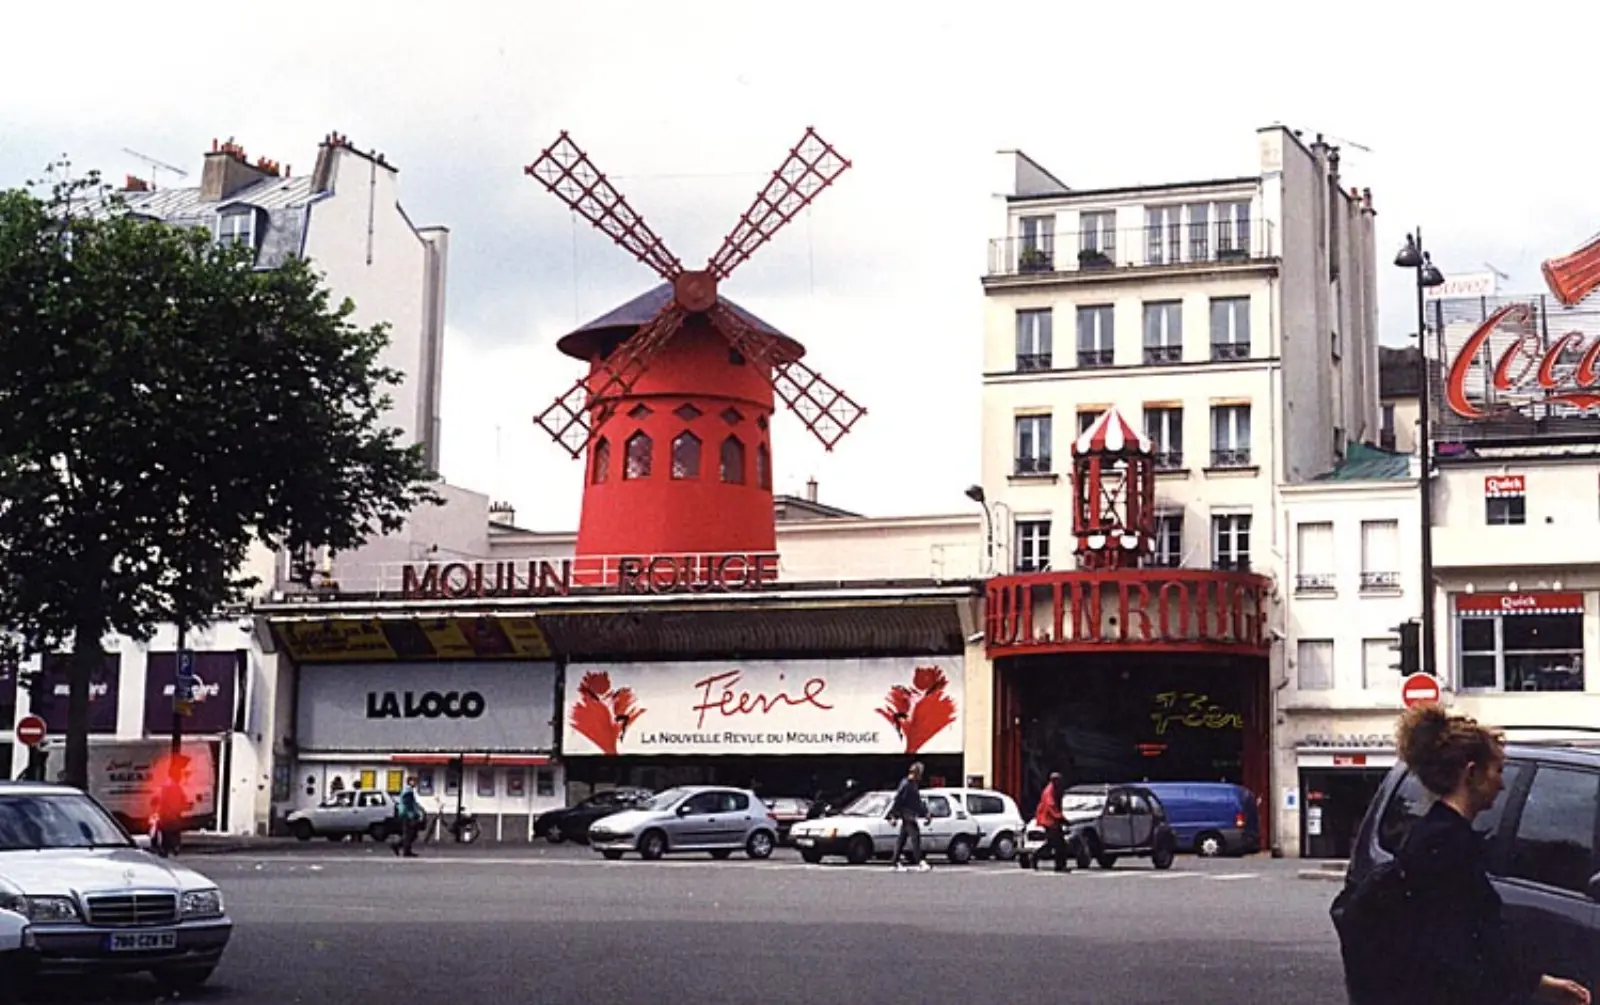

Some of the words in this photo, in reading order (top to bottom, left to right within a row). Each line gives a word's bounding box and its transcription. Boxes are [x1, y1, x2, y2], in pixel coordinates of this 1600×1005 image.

[1487, 479, 1523, 492] Quick
[402, 560, 571, 599] MOULIN
[617, 554, 781, 594] ROUGE
[1501, 596, 1537, 610] Quick
[366, 691, 401, 719] LA
[403, 691, 487, 719] LOCO
[640, 732, 656, 745] LA
[659, 731, 719, 744] NOUVELLE
[723, 731, 761, 744] REVUE
[767, 731, 783, 744] DU
[787, 731, 833, 744] MOULIN
[837, 731, 879, 743] ROUGE
